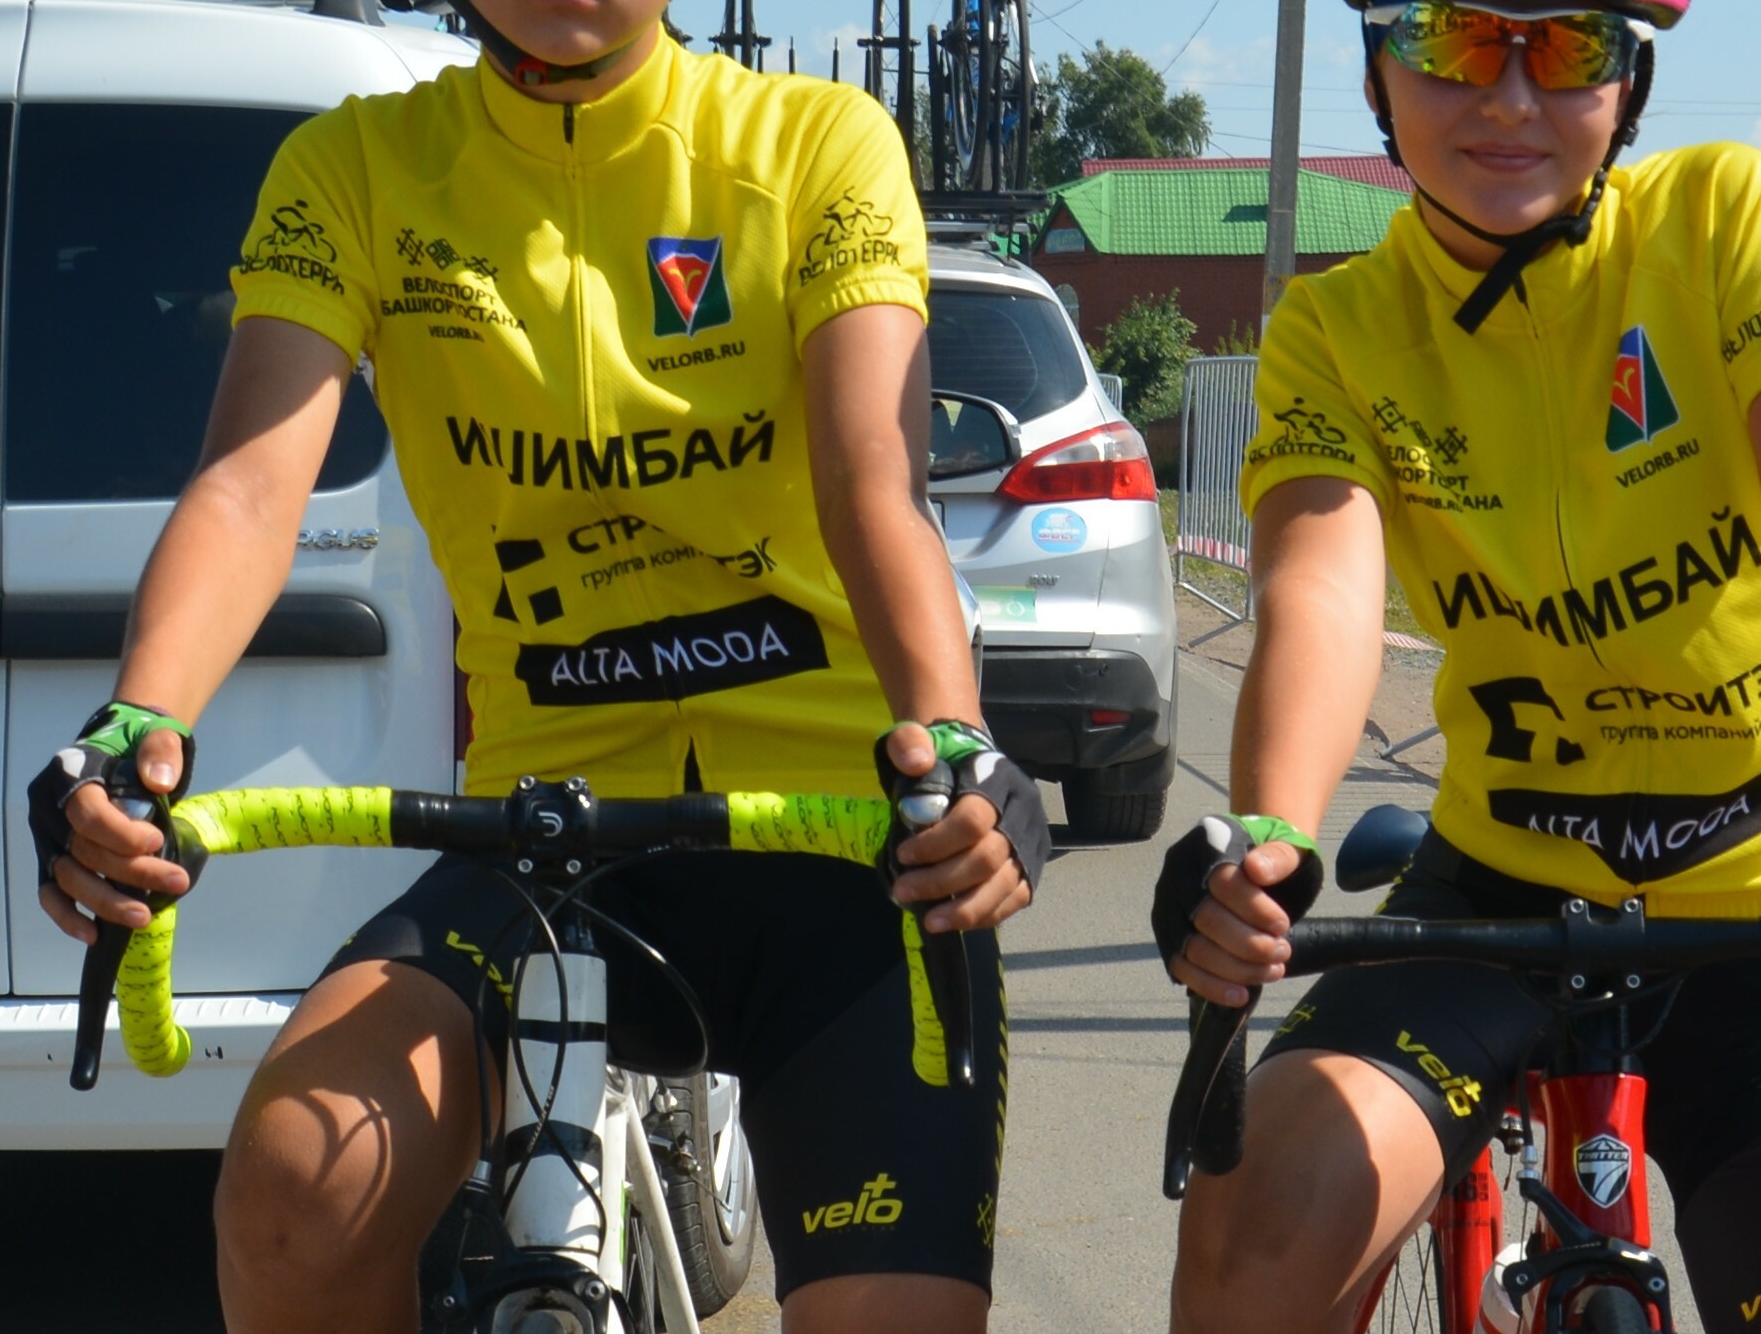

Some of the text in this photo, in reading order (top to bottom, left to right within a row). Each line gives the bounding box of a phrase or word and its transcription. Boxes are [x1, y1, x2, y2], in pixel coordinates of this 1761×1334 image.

[646, 340, 746, 372] VELORB.RU
[1615, 438, 1700, 489] VELORB.RU
[551, 621, 790, 686] ALTA MODA
[1619, 792, 1751, 861] MODA
